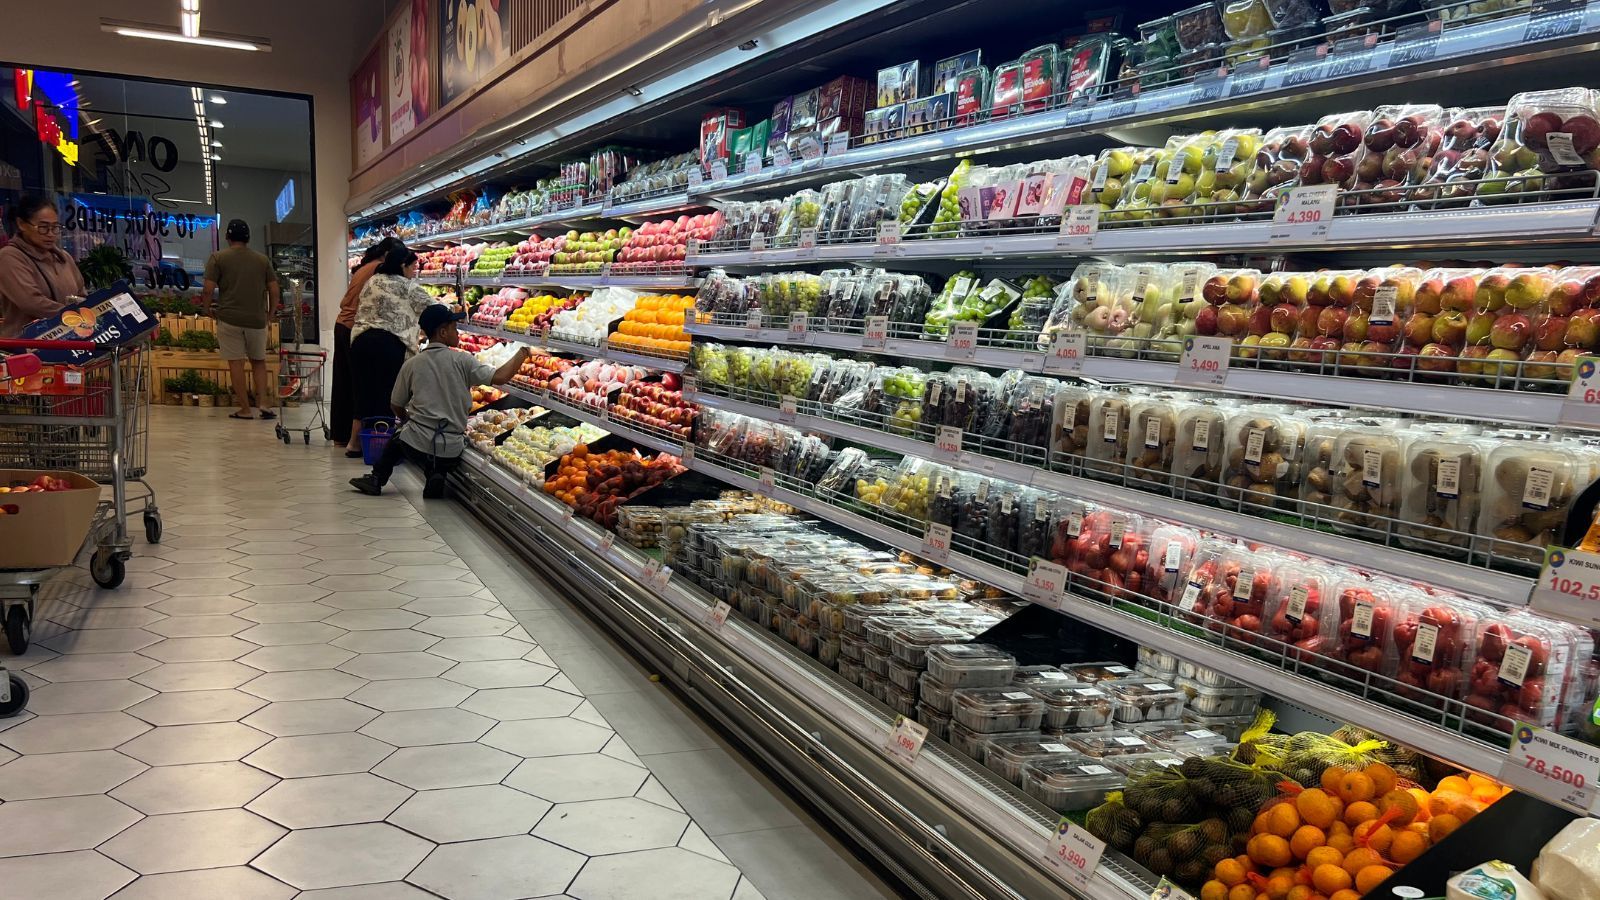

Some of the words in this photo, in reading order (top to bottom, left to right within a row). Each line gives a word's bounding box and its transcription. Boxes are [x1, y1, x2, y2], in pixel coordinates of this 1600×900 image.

[1191, 358, 1219, 373] 3,490
[1569, 558, 1584, 567] KIWI
[1523, 753, 1586, 789] 78,500
[1058, 843, 1086, 870] 3,990
